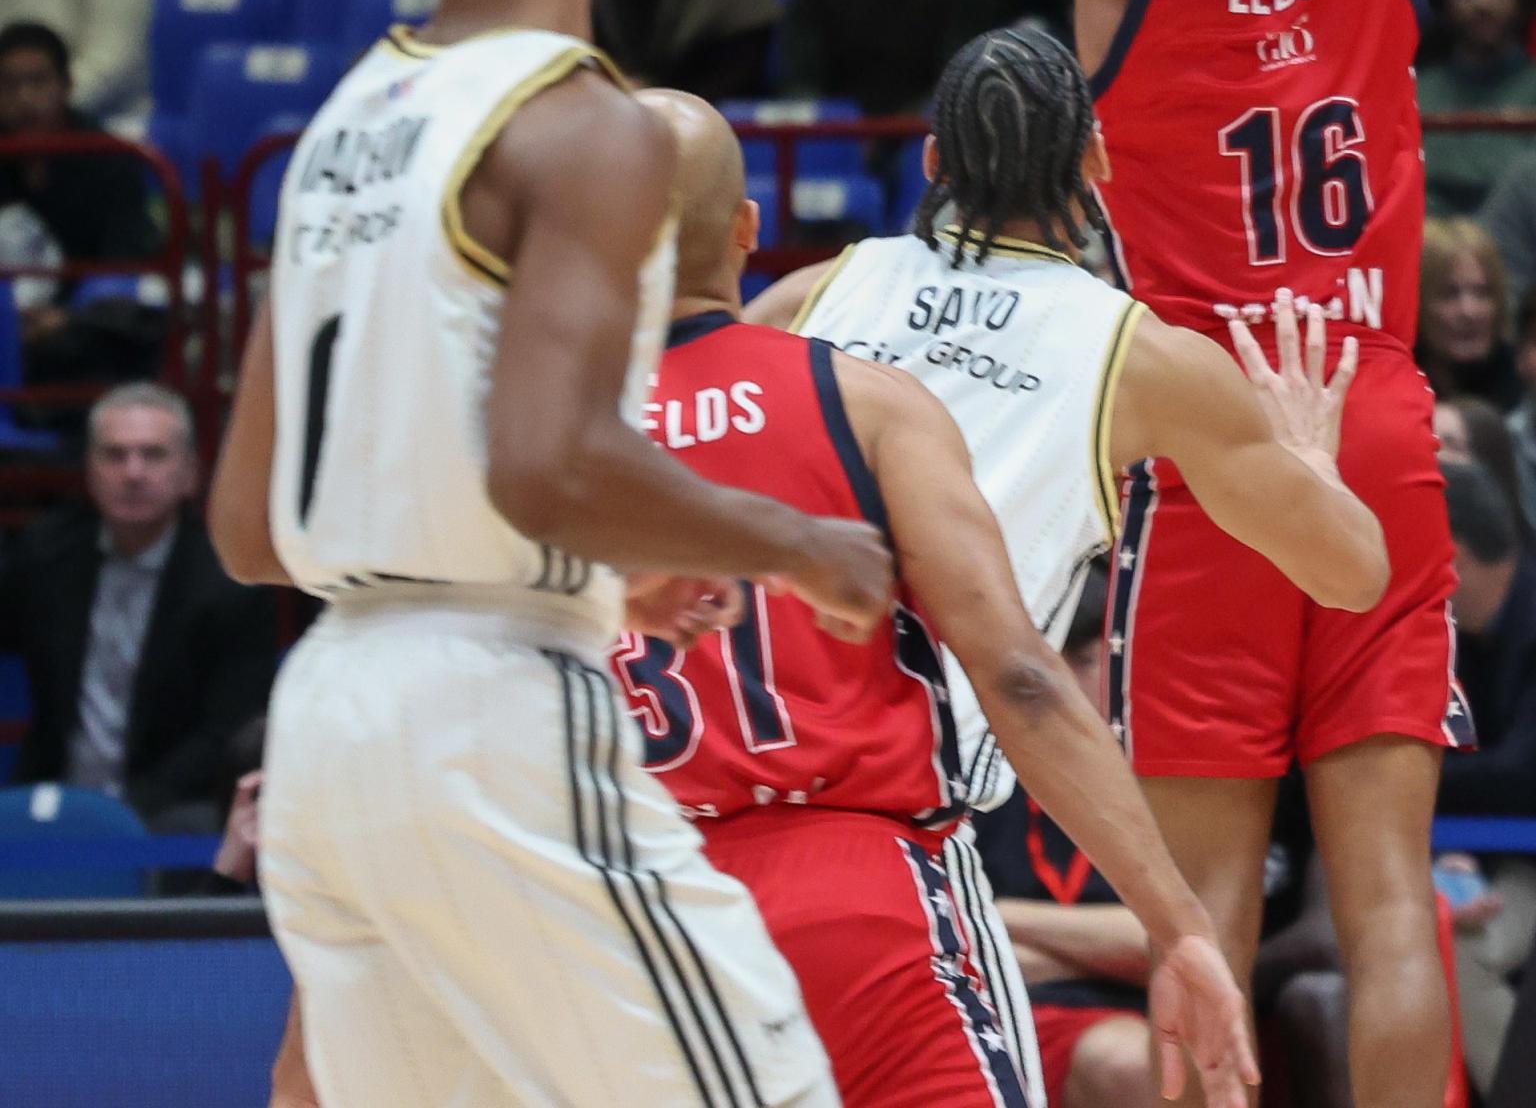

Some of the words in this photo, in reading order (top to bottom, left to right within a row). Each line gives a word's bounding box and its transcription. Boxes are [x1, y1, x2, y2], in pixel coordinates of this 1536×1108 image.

[1218, 96, 1376, 266] 16
[642, 380, 767, 449] ELDS
[612, 578, 797, 774] 31
